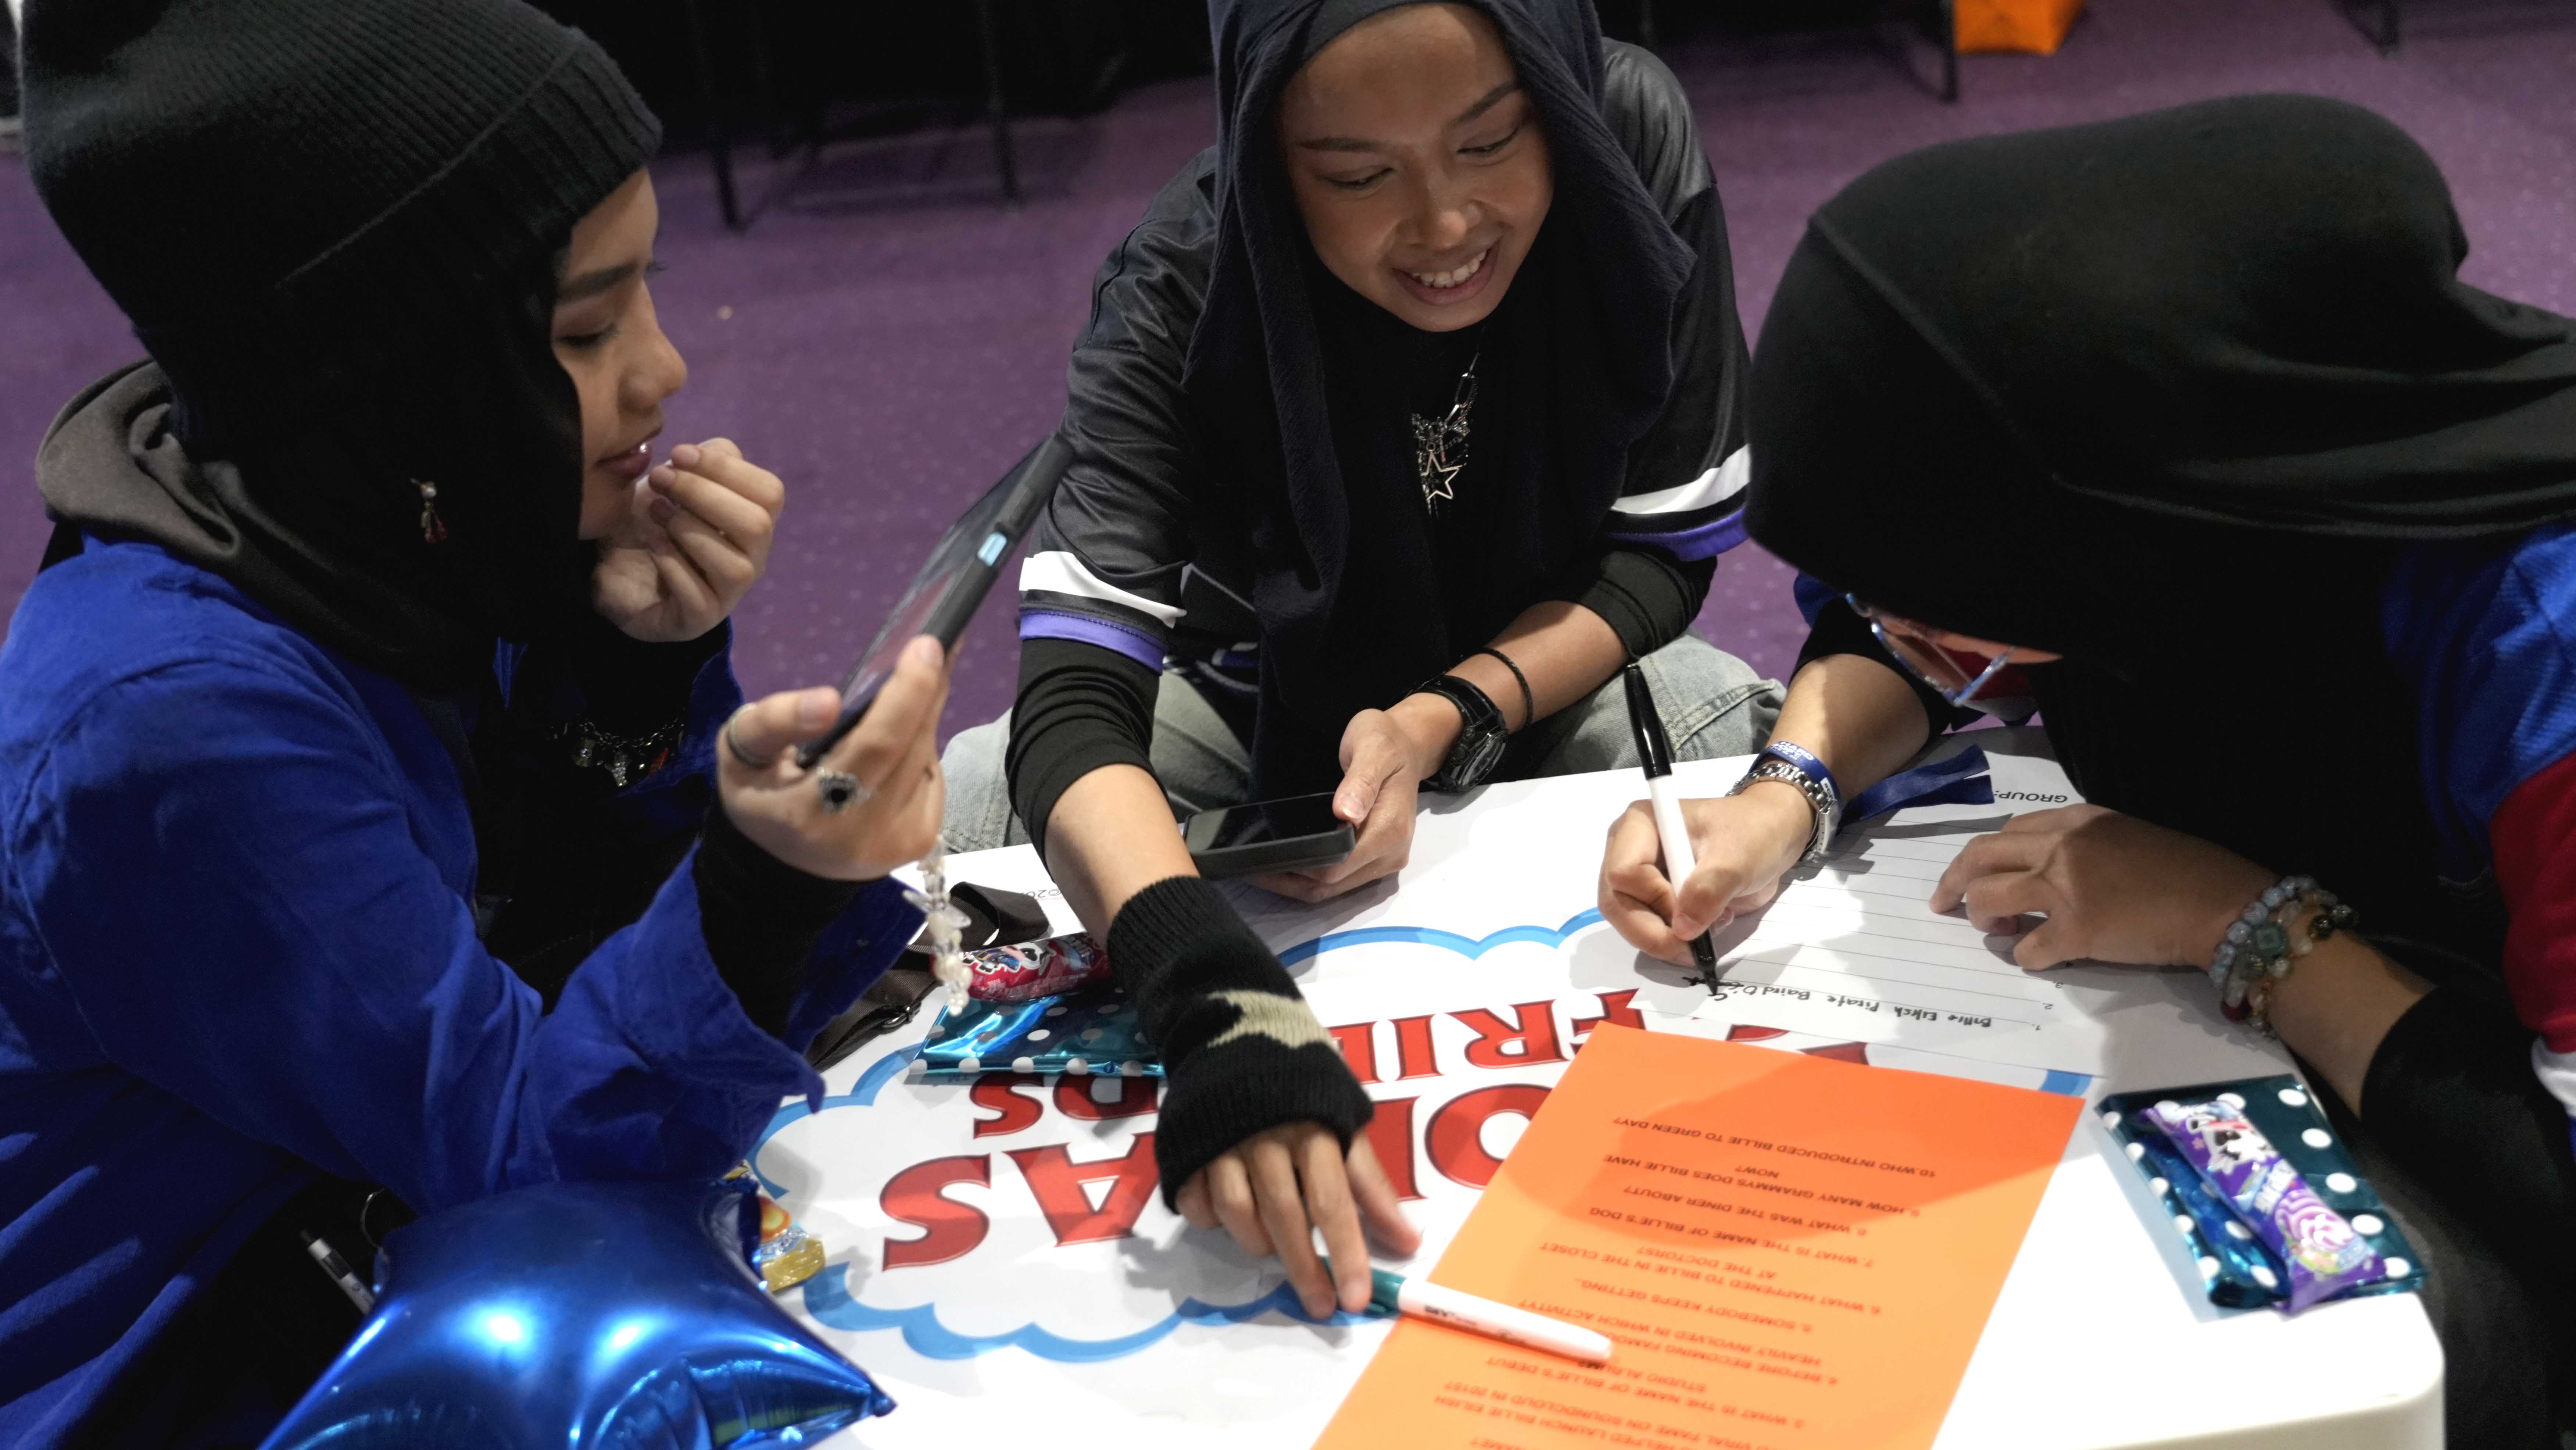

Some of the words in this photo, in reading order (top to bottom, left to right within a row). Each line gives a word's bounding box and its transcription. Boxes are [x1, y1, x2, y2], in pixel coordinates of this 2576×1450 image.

[1994, 790, 2068, 803] GROUP:
[1022, 888, 1062, 899] ©20
[1762, 986, 1810, 1000] Baird
[1827, 995, 1879, 1012] Pirate
[970, 988, 1639, 1139] FRIDS
[1613, 1118, 1649, 1128] DAY?
[1652, 1124, 1701, 1137] GREEN
[1705, 1133, 1722, 1142] TO
[1728, 1137, 1772, 1150] BILLIE
[1604, 1156, 1641, 1166] HAVE
[1777, 1146, 1875, 1167] INTRODUCED
[1644, 1162, 1688, 1176] BILLIE
[1735, 1166, 1779, 1178] NOW?
[1693, 1171, 1733, 1183] DOES
[1624, 1186, 1682, 1202] ABOUT?
[1737, 1179, 1813, 1198] GRAMMYS
[1686, 1198, 1732, 1212] DINER
[1818, 1194, 1862, 1207] MANY
[1866, 1202, 1903, 1212] HOW
[1589, 1207, 1622, 1219] DOG
[1737, 1207, 1763, 1218] THE
[1770, 1213, 1802, 1225] WAS
[1626, 1215, 1685, 1232] BILLIE'S
[1807, 1220, 1849, 1232] WHAT
[1688, 1228, 1709, 1236] OF
[1713, 1232, 1757, 1244] NAME
[1540, 1243, 1598, 1259] CLOSET
[1763, 1240, 1789, 1252] THE
[1602, 1254, 1629, 1266] THE
[1637, 1247, 1719, 1268] DOCTORS?
[1815, 1251, 1857, 1264] WHAT
[1654, 1265, 1701, 1279] BILLIE
[1723, 1262, 1751, 1275] THE
[1757, 1270, 1776, 1279] AT
[1704, 1274, 1724, 1285] TO
[1729, 1280, 1814, 1301] HAPPENED
[1651, 1295, 1701, 1310] KEEPS
[1820, 1297, 1864, 1311] WHAT
[1518, 1300, 1594, 1321] ACTIVITY?
[1705, 1306, 1795, 1329] SOMEBODY
[1597, 1316, 1649, 1332] WHICH
[1674, 1331, 1752, 1353] INVOLVED
[1666, 1345, 1752, 1369] BECOMING
[1756, 1348, 1821, 1365] HEAVILY
[1486, 1358, 1538, 1374] DEBUT
[1757, 1364, 1821, 1382] BEFORE
[1542, 1368, 1604, 1388] BILLIE'S
[1647, 1374, 1705, 1392] STUDIO
[1608, 1383, 1629, 1393] OF
[1635, 1388, 1680, 1404] NAME
[1511, 1396, 1622, 1425] SOUNDCLOUD
[1685, 1399, 1714, 1411] THE
[1488, 1408, 1536, 1424] BILLIE
[1740, 1411, 1786, 1425] WHAT
[1539, 1418, 1606, 1439] LAUNCH
[1625, 1419, 1651, 1431] ON
[1656, 1426, 1699, 1442] FAME
[1610, 1434, 1675, 1450] HELPED
[1707, 1435, 1750, 1450] VIRAL
